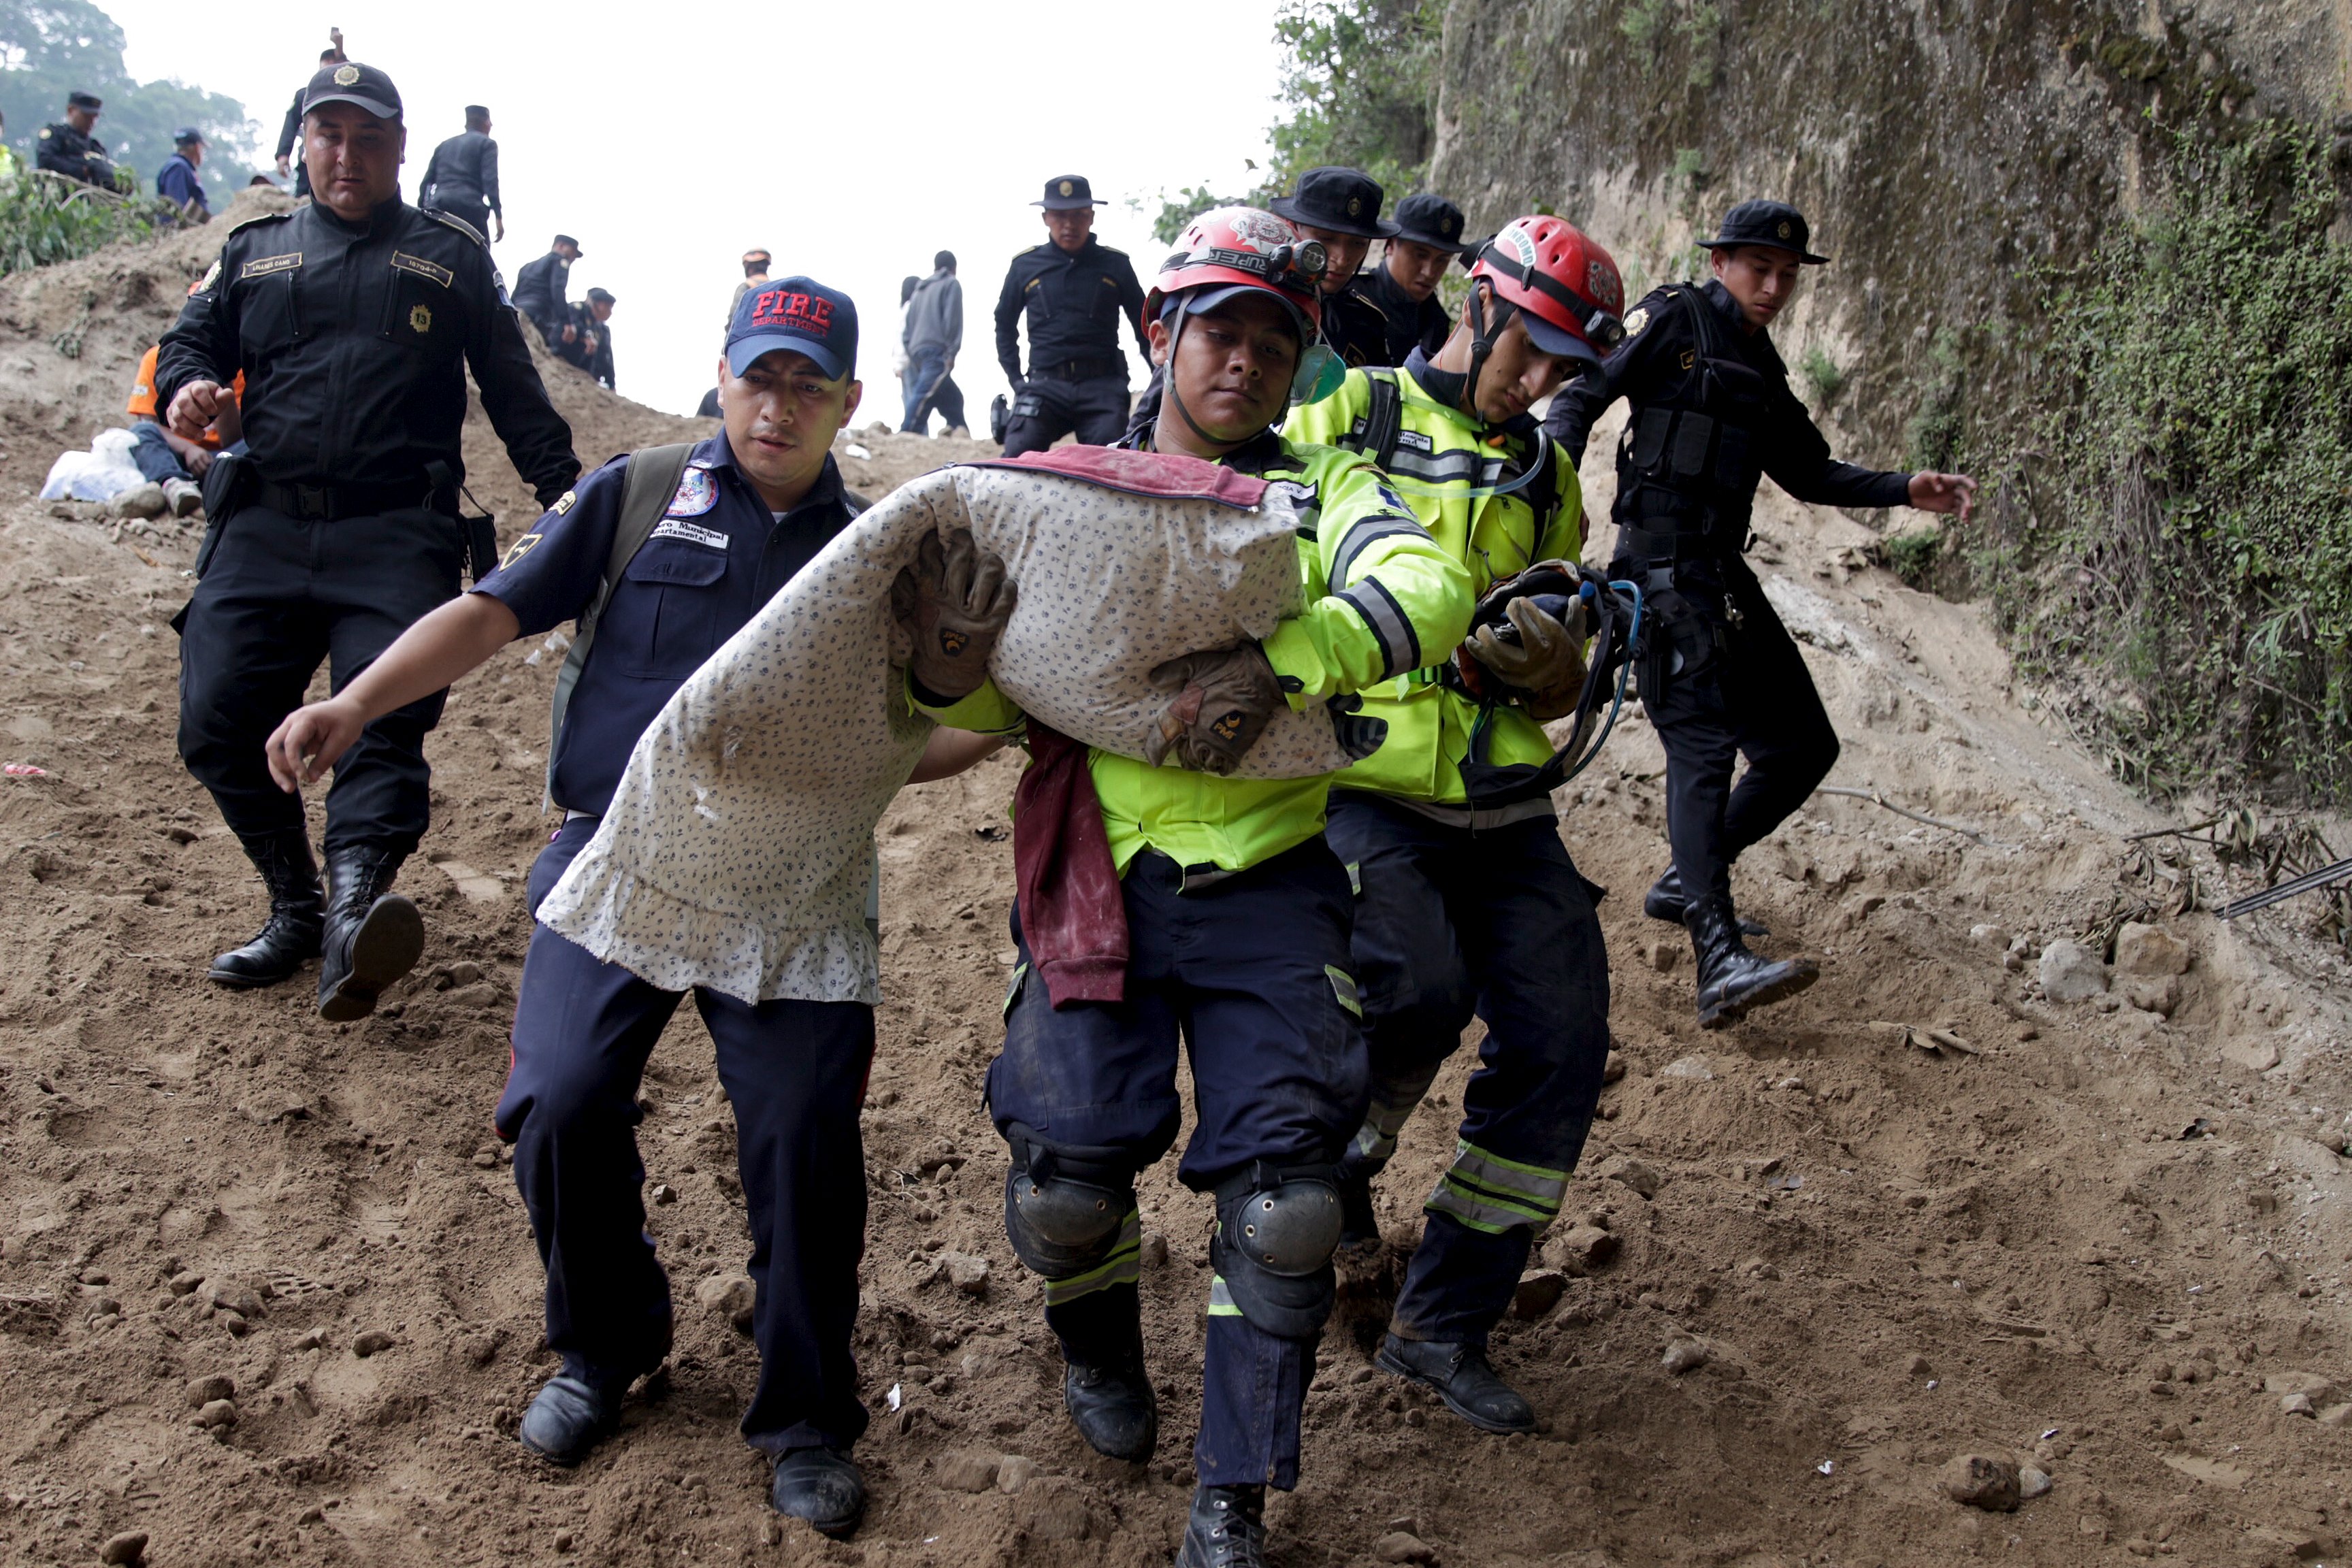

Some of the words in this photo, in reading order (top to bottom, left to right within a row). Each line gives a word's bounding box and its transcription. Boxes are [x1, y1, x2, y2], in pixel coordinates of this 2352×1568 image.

[415, 312, 427, 324] 13
[752, 291, 834, 328] FIRE
[751, 316, 828, 338] DEPARTMENT
[679, 522, 724, 540] Municipal
